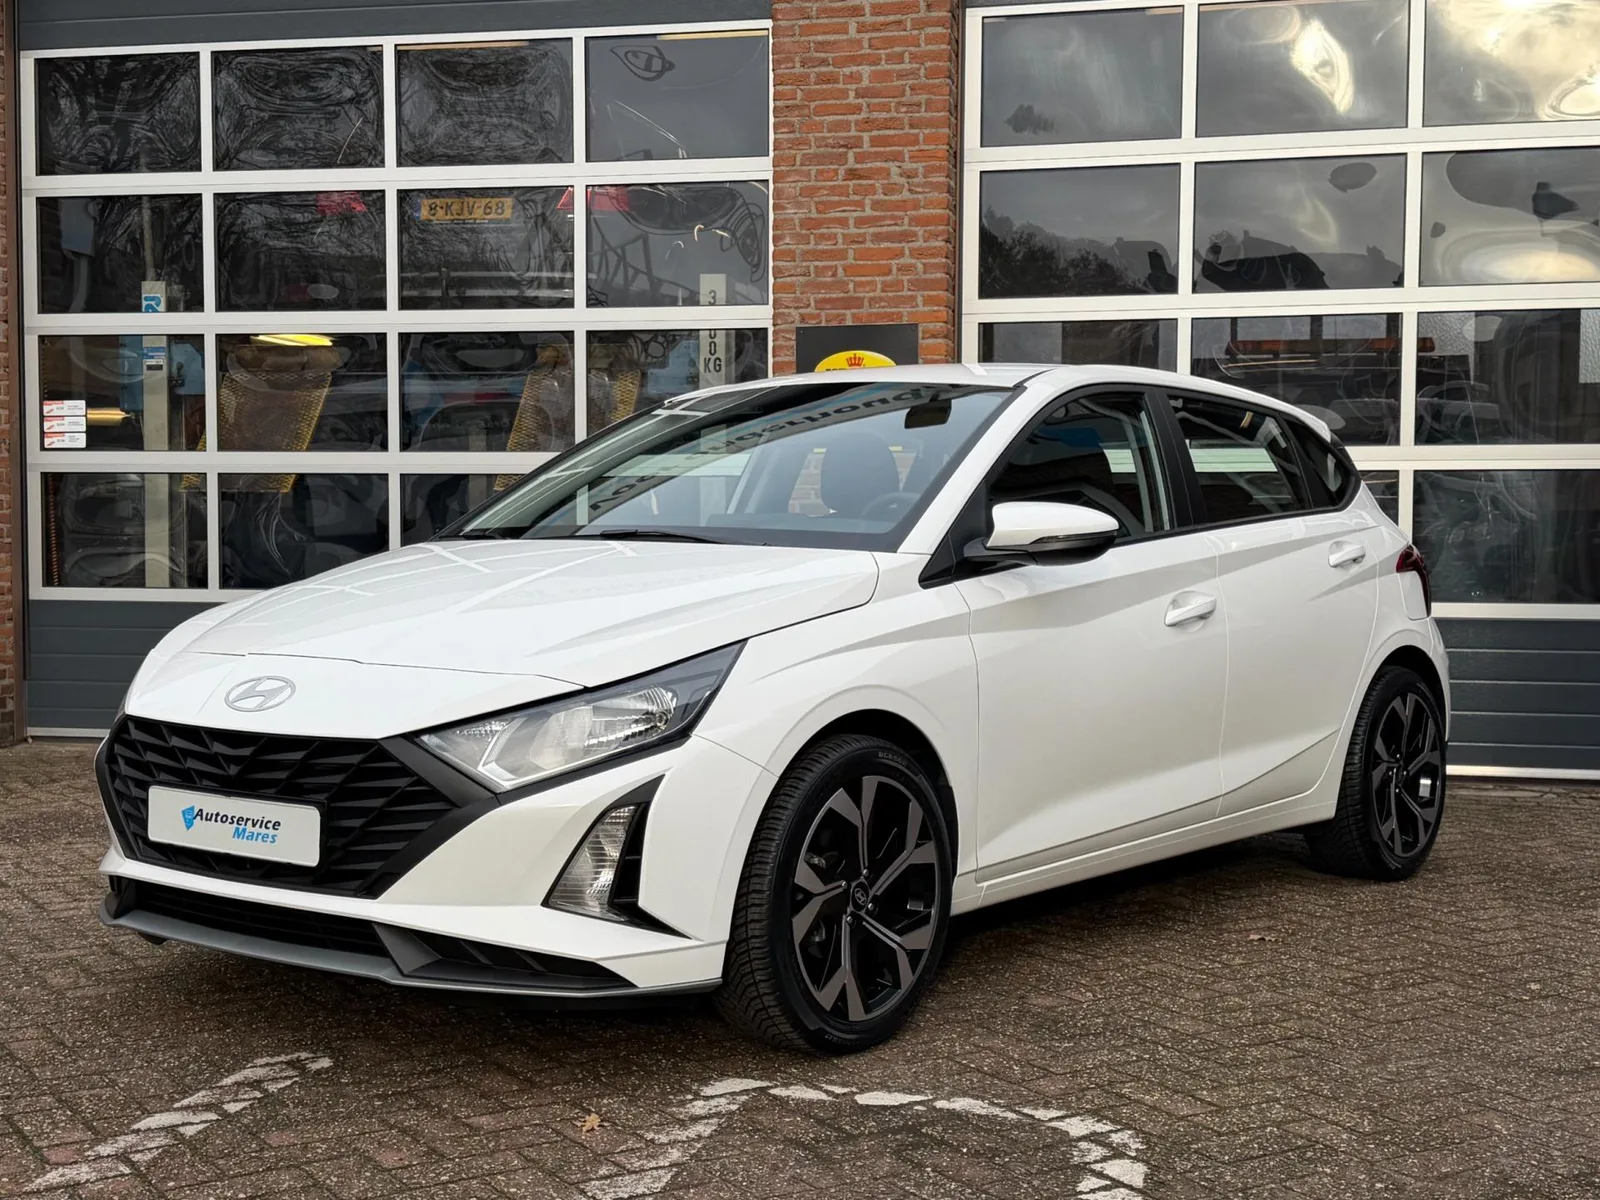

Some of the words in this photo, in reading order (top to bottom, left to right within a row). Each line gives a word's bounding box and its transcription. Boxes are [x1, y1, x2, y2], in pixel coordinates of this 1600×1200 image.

[427, 200, 506, 217] 8-KJV-68
[703, 357, 723, 373] KG
[193, 808, 282, 831] Autoservice
[232, 826, 278, 844] Mares
